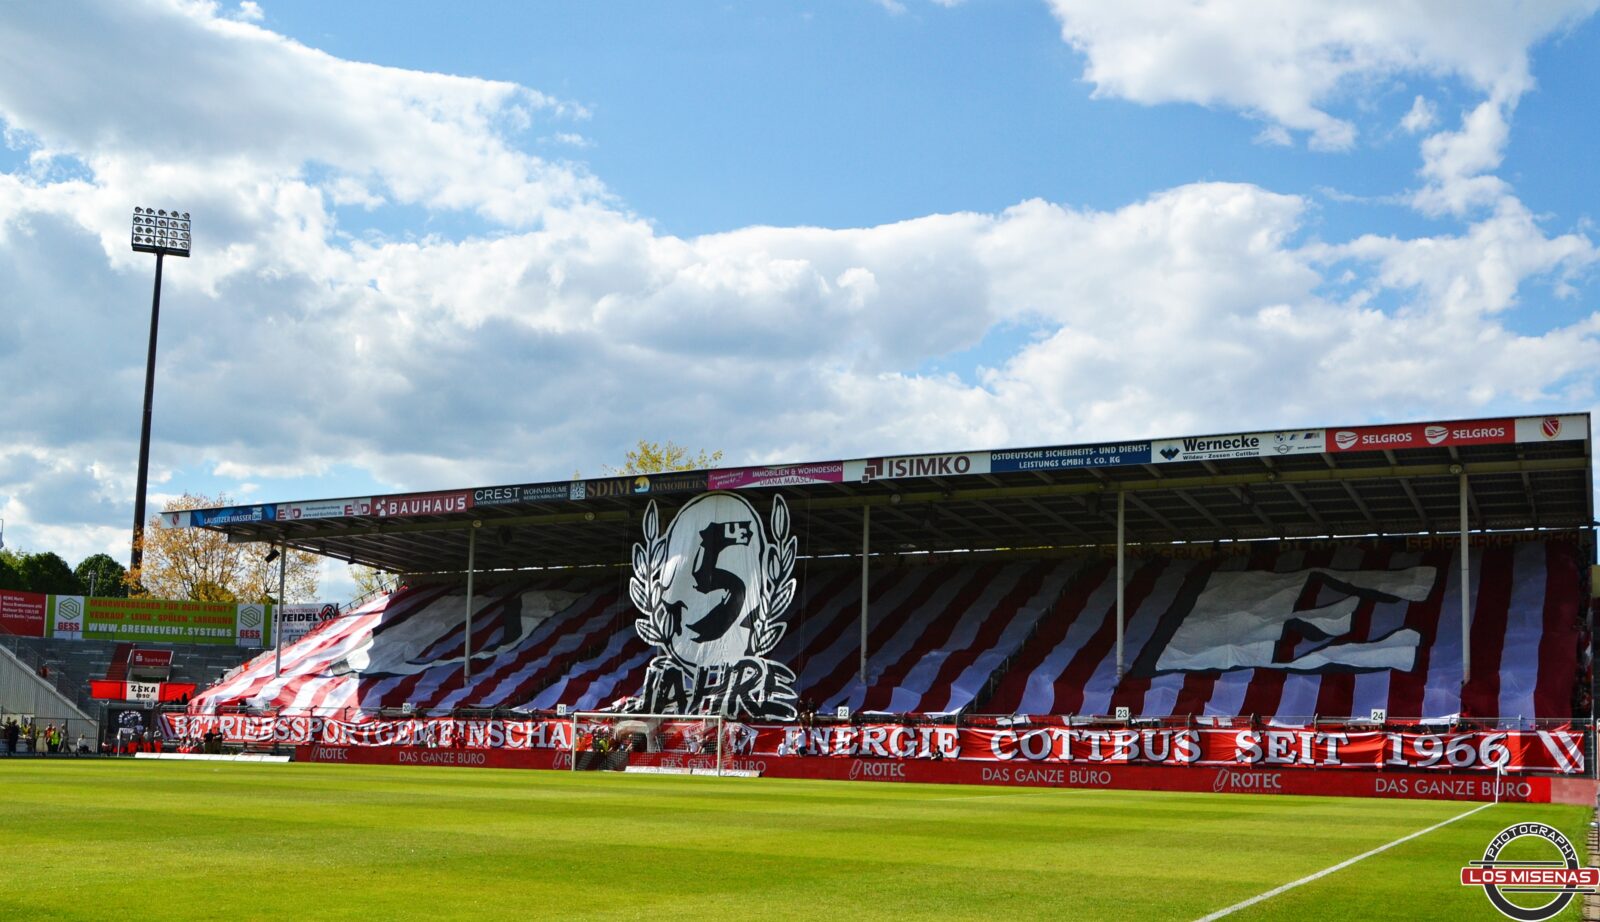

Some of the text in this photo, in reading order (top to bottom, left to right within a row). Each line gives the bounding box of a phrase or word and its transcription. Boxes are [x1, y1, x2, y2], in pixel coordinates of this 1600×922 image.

[1362, 432, 1412, 444] SELGROS
[1453, 428, 1504, 439] SELGROS
[1183, 435, 1260, 452] Wernecke
[992, 444, 1150, 461] OSTDEUTSCHE SICHERHEITS- UND DIENST-
[888, 455, 970, 478] ISIMKO
[1019, 456, 1120, 469] LEISTUNGS GMBH & CO. KG
[752, 470, 789, 478] IMMOBILIEN
[798, 466, 842, 474] WOHNDESIGN
[587, 478, 630, 497] SDIM
[652, 480, 708, 492] IMMOBILIEN
[760, 478, 782, 486] DIANA
[474, 487, 520, 501] CREST
[389, 496, 466, 514] BAUHAUS
[204, 514, 252, 525] LAUSITZER WASSER
[58, 622, 80, 631] GESS
[88, 623, 232, 637] WWW.GREENEVENT.SYSTEMS
[240, 630, 260, 638] GESS
[131, 685, 156, 693] ZSKA
[624, 655, 798, 723] JAHRE
[559, 706, 565, 714] 21
[1118, 710, 1128, 718] 23
[1372, 712, 1384, 721] 24
[782, 726, 1512, 768] ENERGIE COTTBUS SEIT 1966
[320, 748, 348, 760] ROTEC
[400, 750, 486, 764] DAS GANZE BÜRO
[864, 762, 906, 777] ROTEC
[982, 768, 1112, 785] DAS GANZE BÜRO
[1231, 772, 1282, 788] ROTEC
[1375, 778, 1408, 793] DAS
[1415, 780, 1475, 796] GANZE
